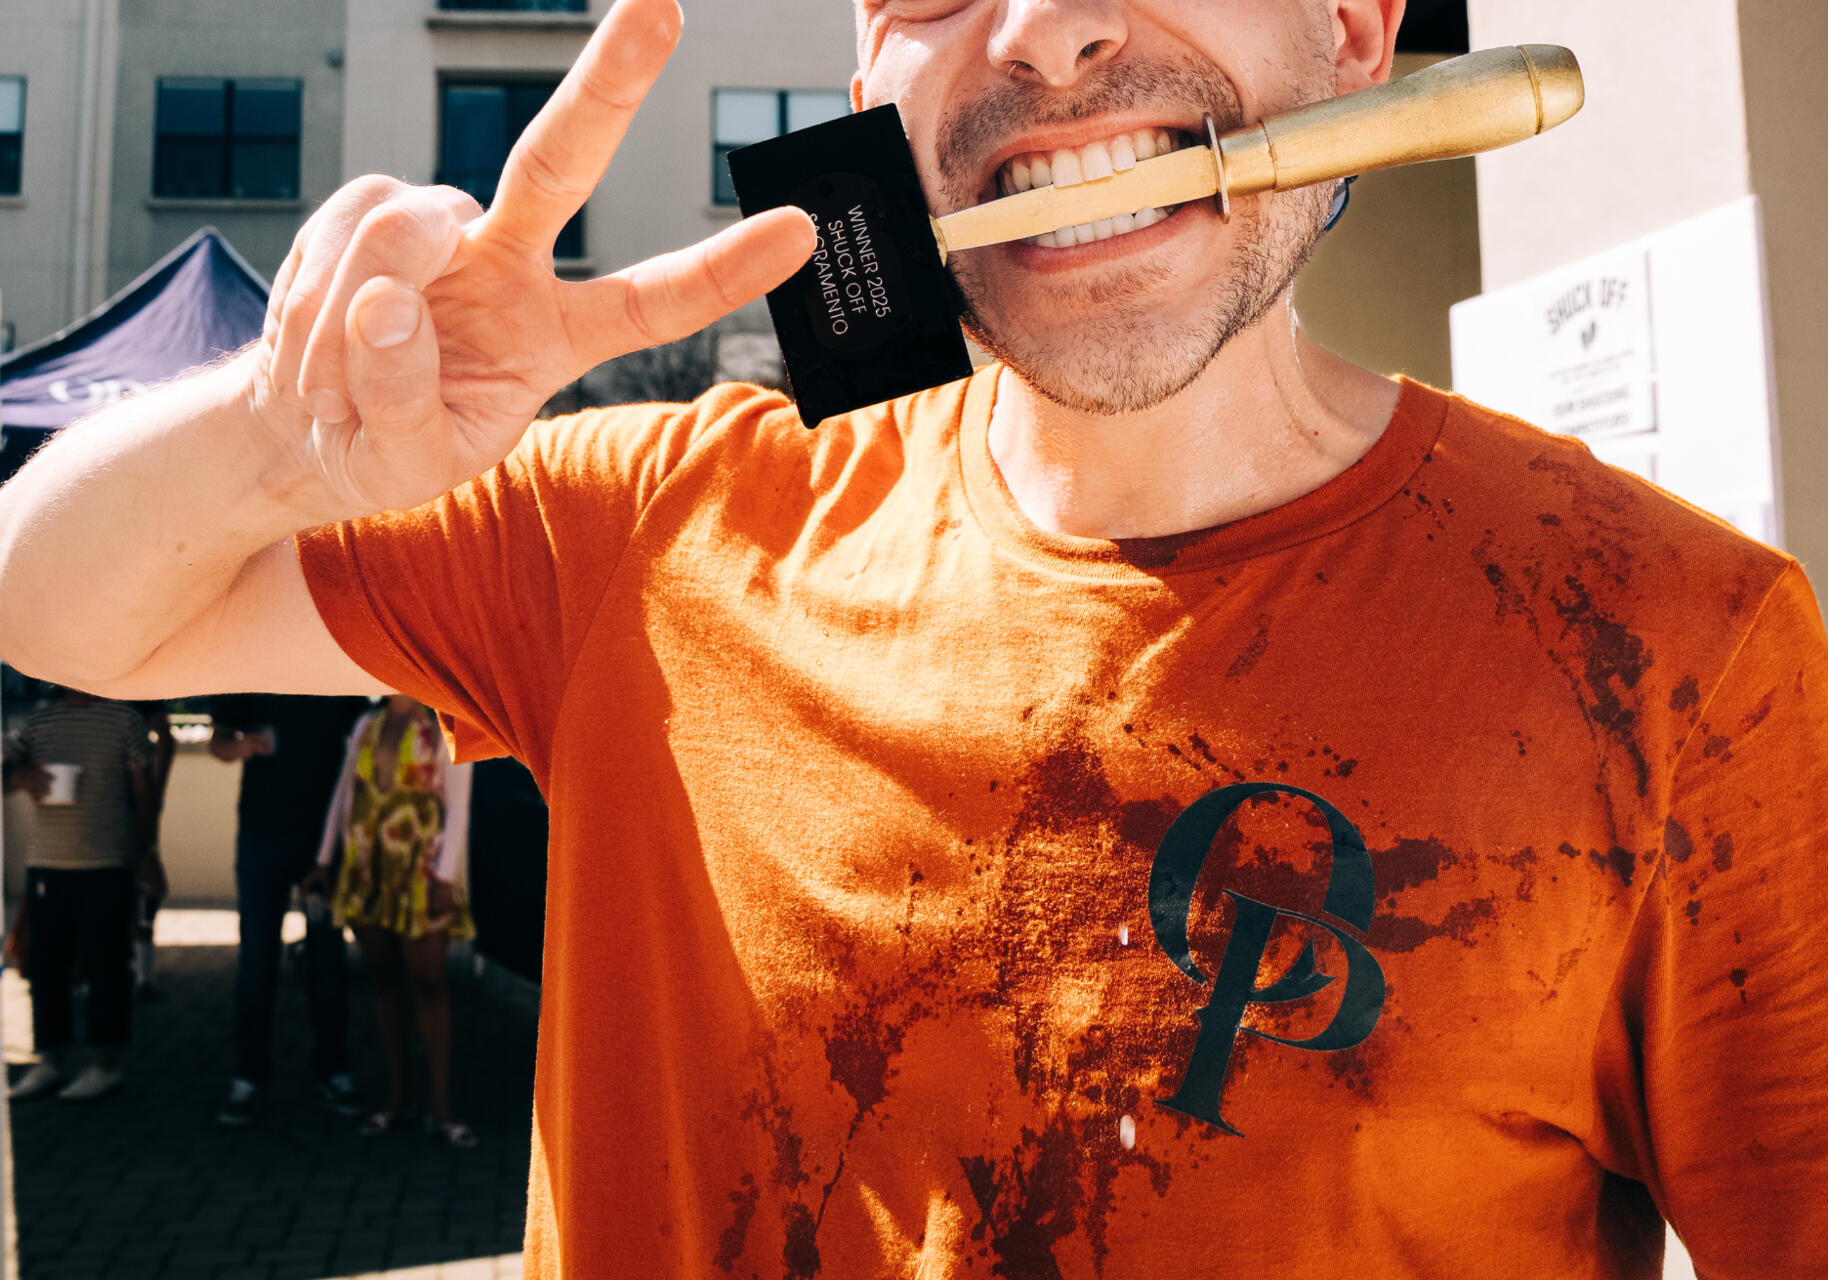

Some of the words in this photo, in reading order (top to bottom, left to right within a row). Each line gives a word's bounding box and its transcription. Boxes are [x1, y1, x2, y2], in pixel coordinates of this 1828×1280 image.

[827, 219, 857, 280] SHUCK
[845, 282, 867, 314] OFF
[847, 204, 879, 274] WINNER
[866, 276, 892, 318] 2025
[1546, 278, 1592, 335] SHUCK
[1599, 277, 1628, 310] OFF
